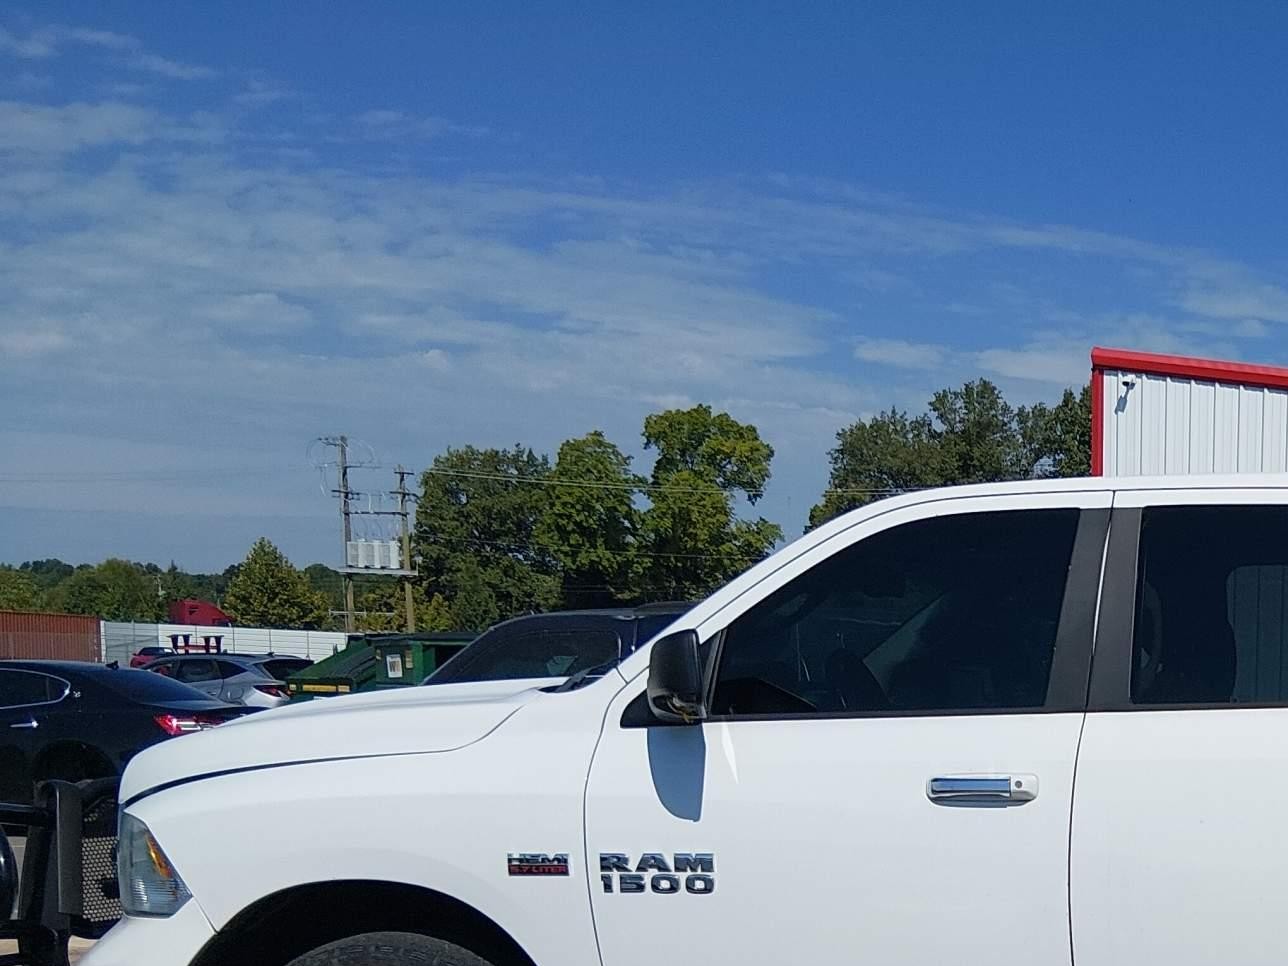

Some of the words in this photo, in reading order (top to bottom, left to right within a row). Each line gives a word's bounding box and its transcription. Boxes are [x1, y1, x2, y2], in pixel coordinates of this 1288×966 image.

[507, 853, 569, 864] HEMI
[599, 853, 714, 872] RAM
[531, 865, 567, 873] LITER
[600, 873, 714, 894] 1500
